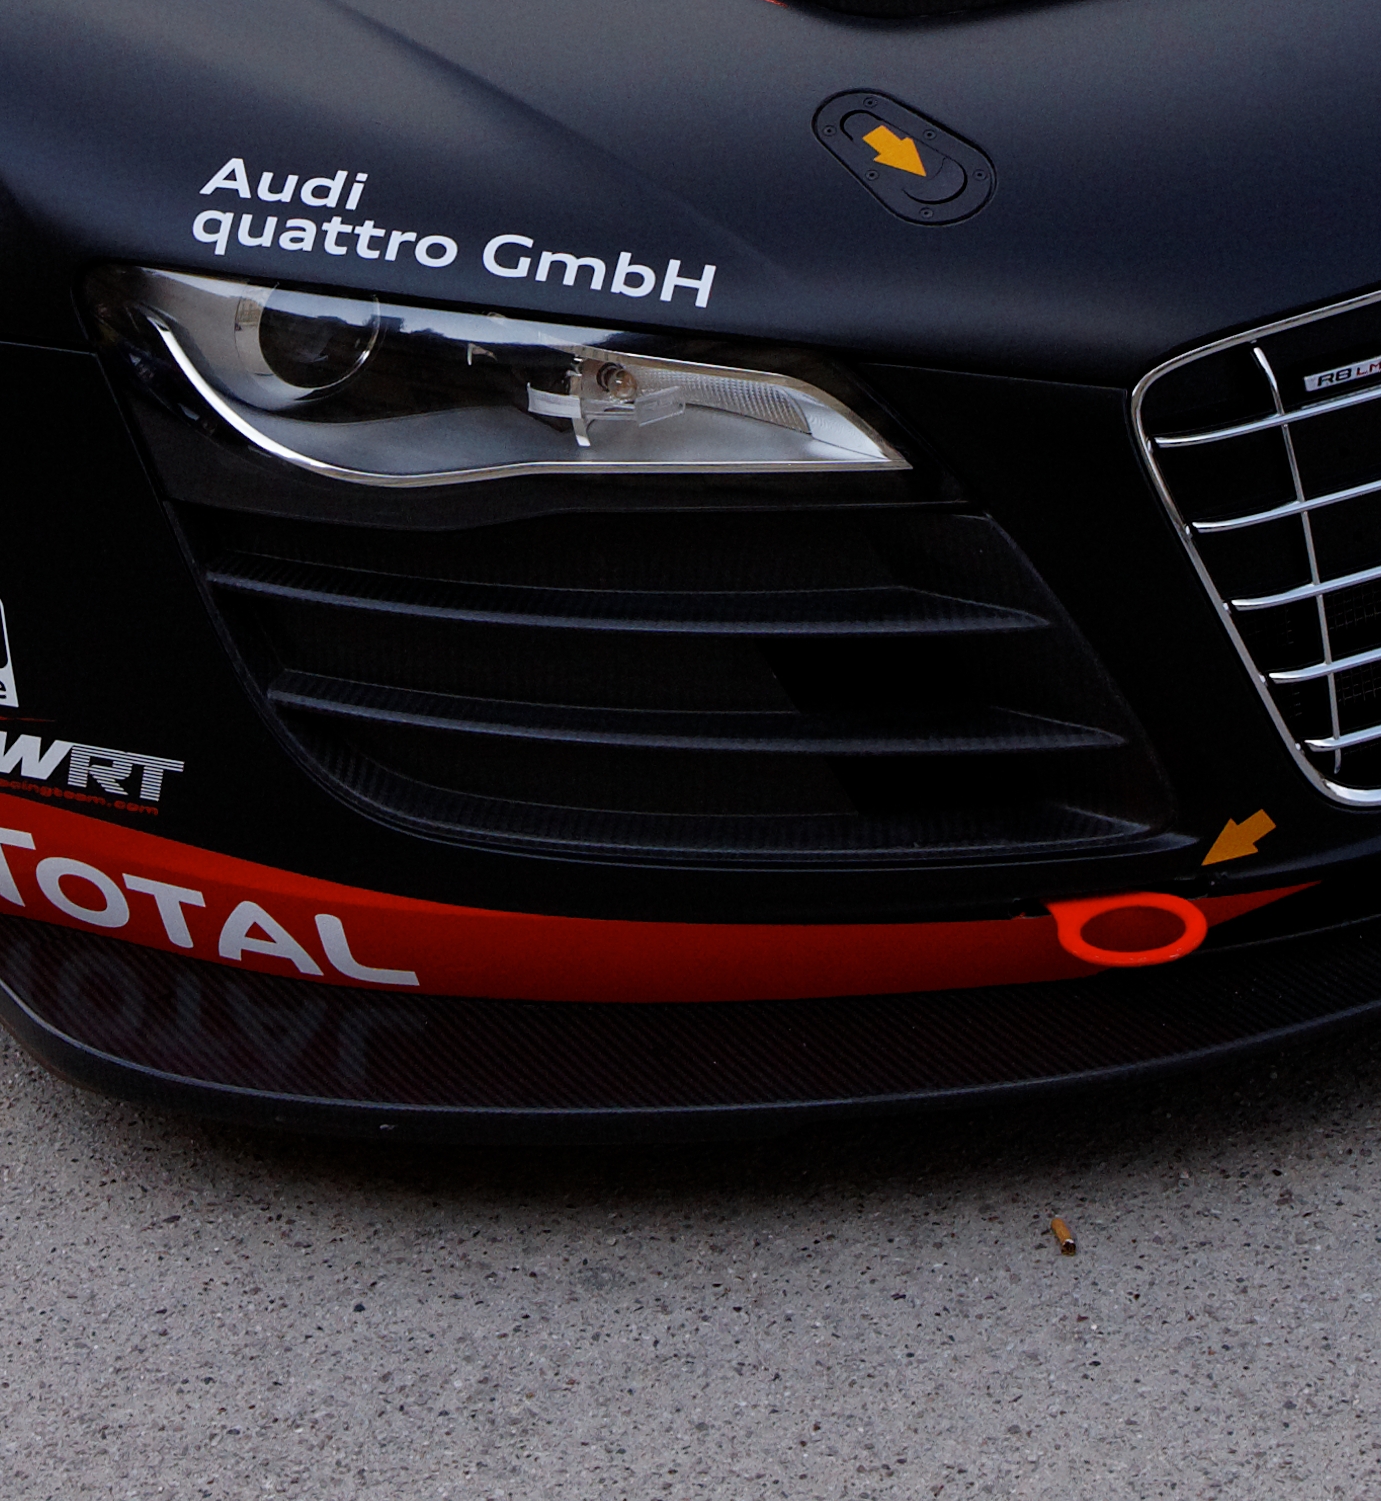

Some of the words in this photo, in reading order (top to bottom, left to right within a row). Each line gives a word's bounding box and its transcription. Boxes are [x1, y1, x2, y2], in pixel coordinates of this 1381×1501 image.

[199, 157, 369, 210] Audi
[191, 204, 459, 269] quattro
[482, 233, 718, 309] GmbH
[1317, 368, 1352, 387] R8
